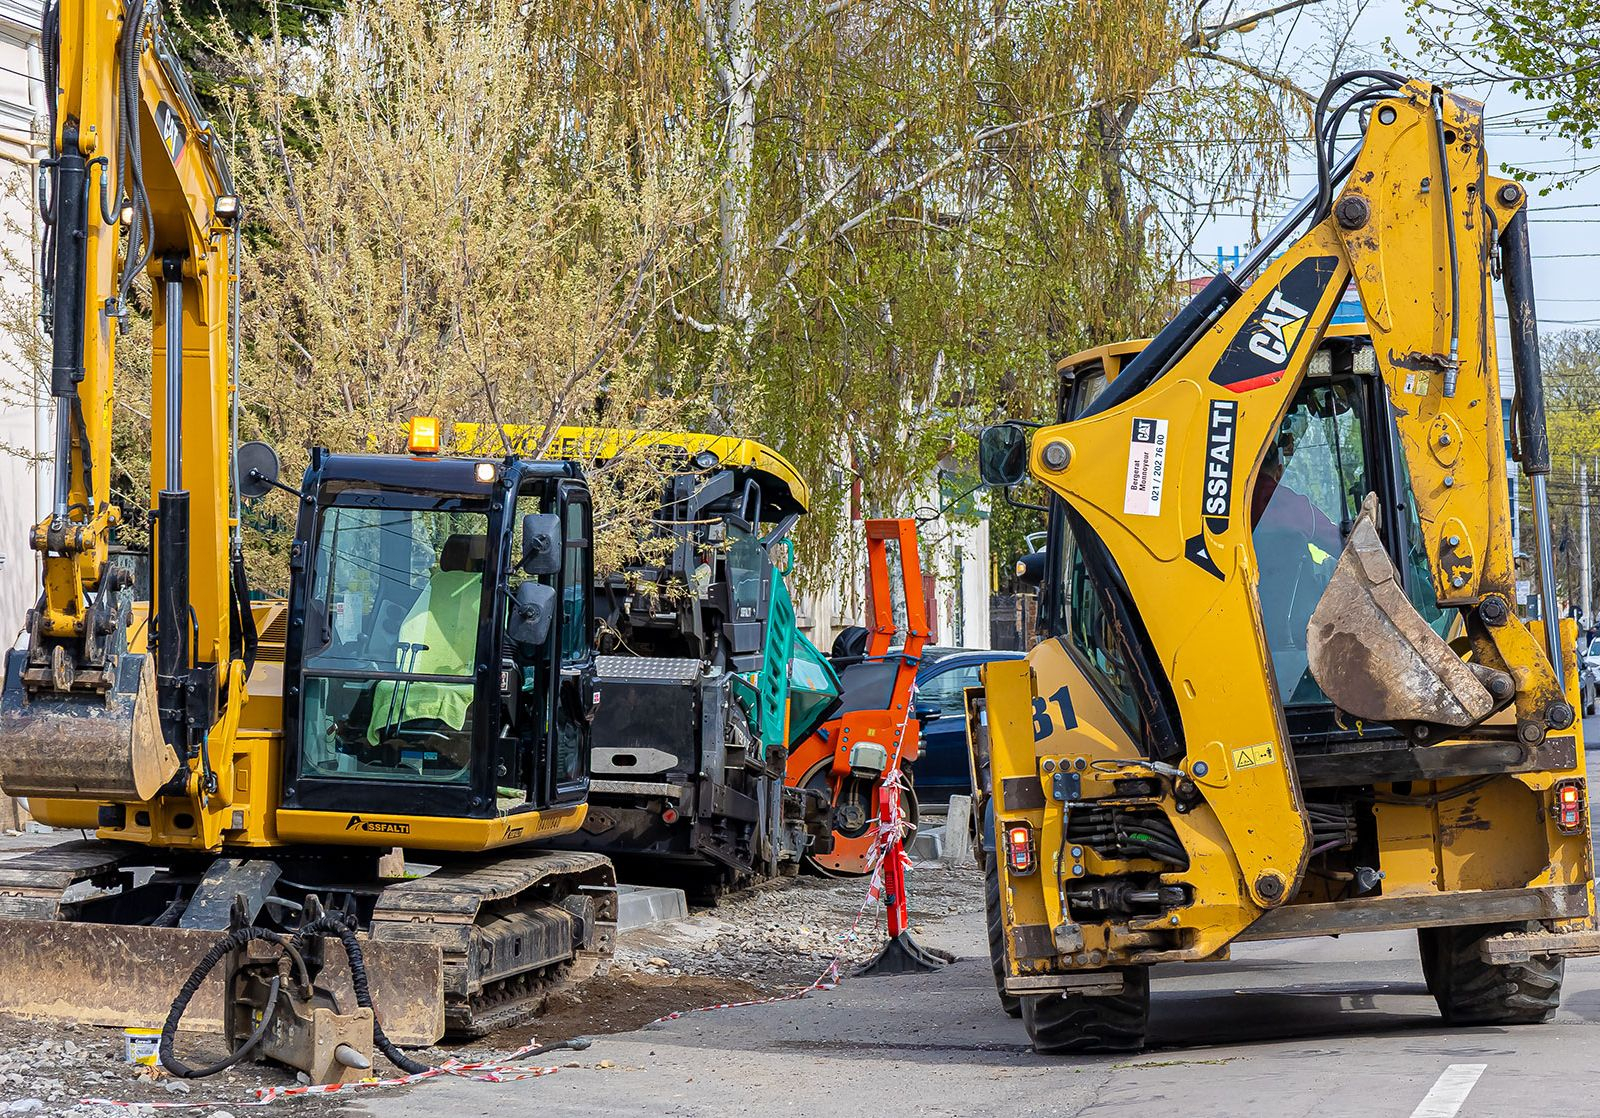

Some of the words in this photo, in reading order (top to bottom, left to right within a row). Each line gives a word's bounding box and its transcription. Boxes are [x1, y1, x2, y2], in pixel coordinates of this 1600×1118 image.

[163, 108, 179, 158] CAT
[1249, 290, 1309, 364] CAT
[1137, 421, 1151, 441] CAT
[1156, 434, 1165, 446] 00
[1155, 447, 1164, 458] 76
[1131, 460, 1140, 491] Bergerat
[1139, 452, 1150, 492] Monnoyeur
[1153, 460, 1163, 477] 202
[1151, 485, 1160, 502] 021
